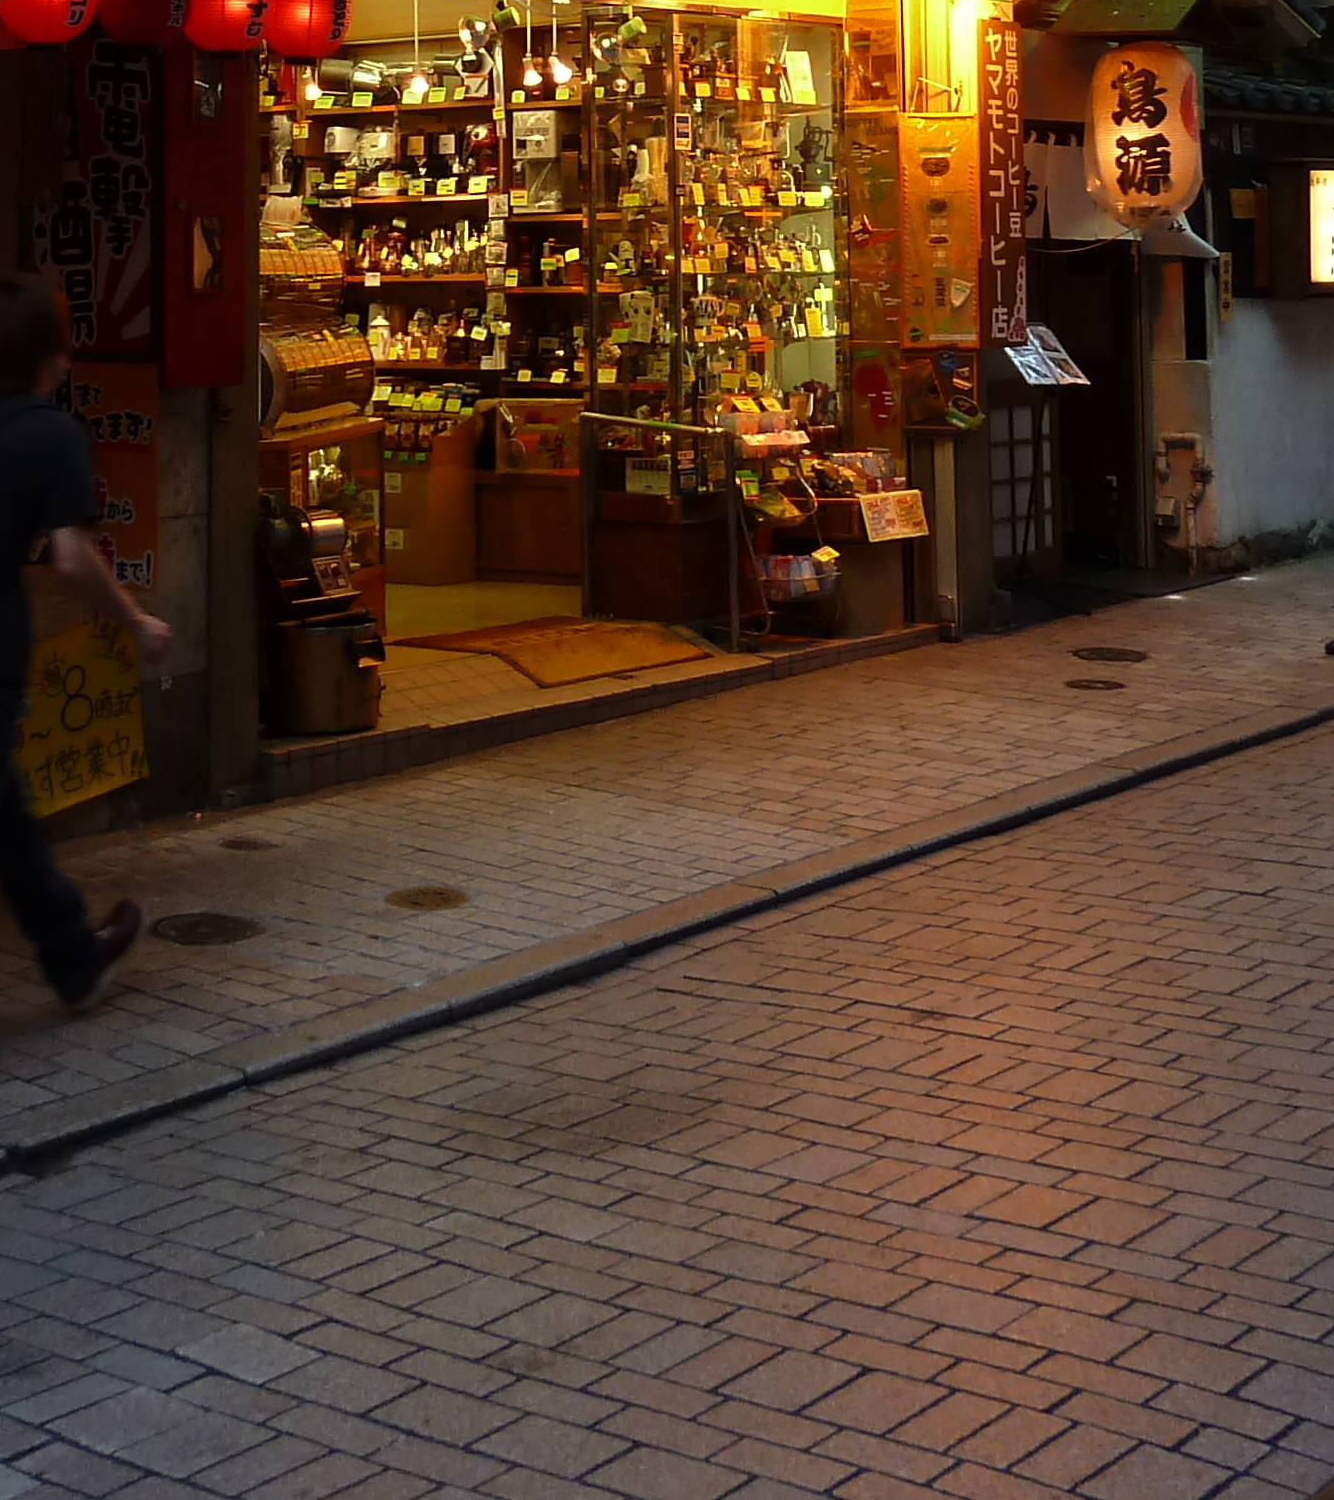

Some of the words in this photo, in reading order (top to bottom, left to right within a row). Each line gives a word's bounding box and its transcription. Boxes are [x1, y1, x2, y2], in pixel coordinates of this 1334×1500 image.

[984, 27, 1008, 339] ヤマモトコーヒー店
[1004, 30, 1022, 238] 世界のコーヒー豆
